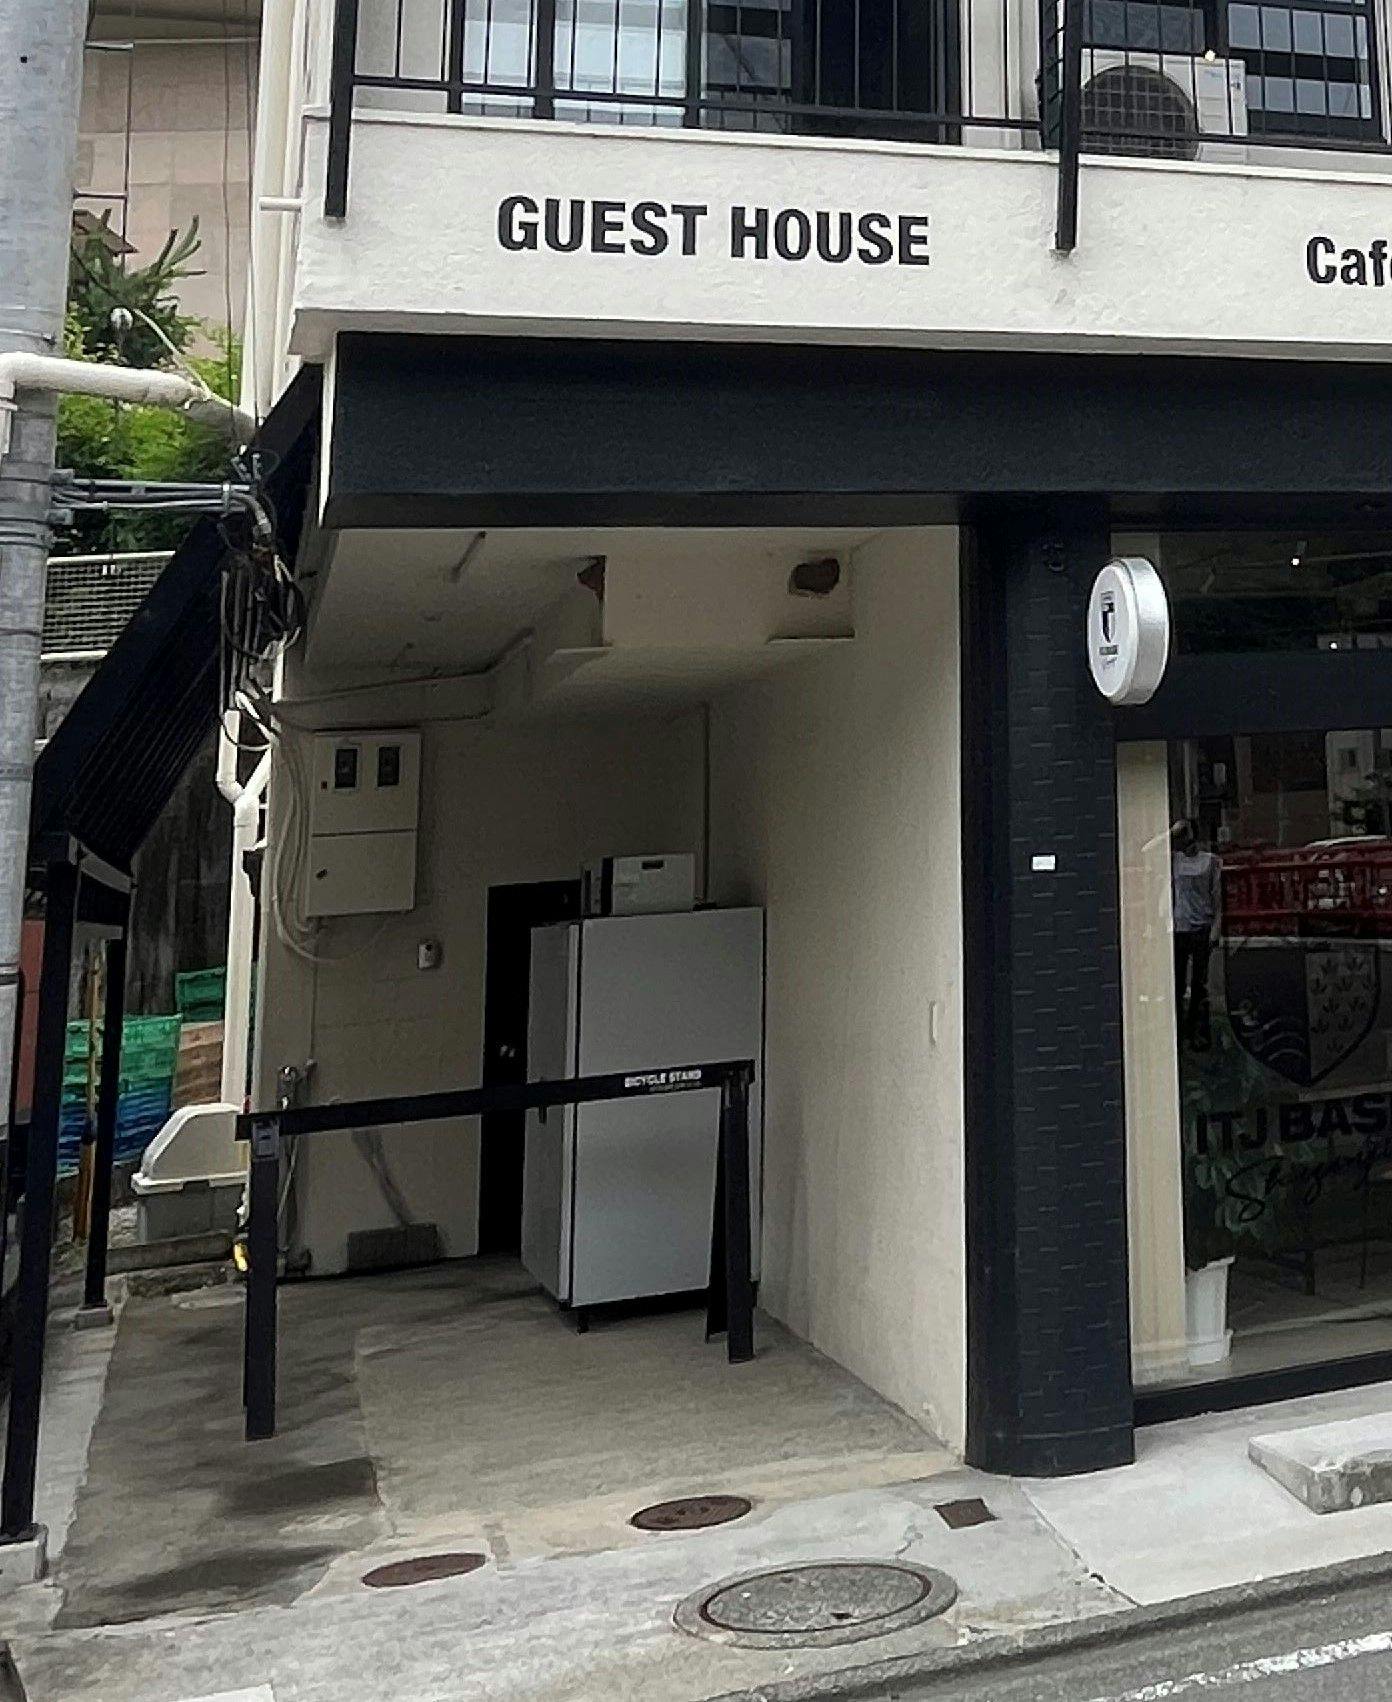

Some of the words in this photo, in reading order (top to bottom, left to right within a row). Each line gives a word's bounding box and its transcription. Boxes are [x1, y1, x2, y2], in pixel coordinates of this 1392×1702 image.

[498, 194, 708, 256] GUEST
[730, 206, 930, 266] HOUSE
[1196, 1107, 1267, 1154] ITJ
